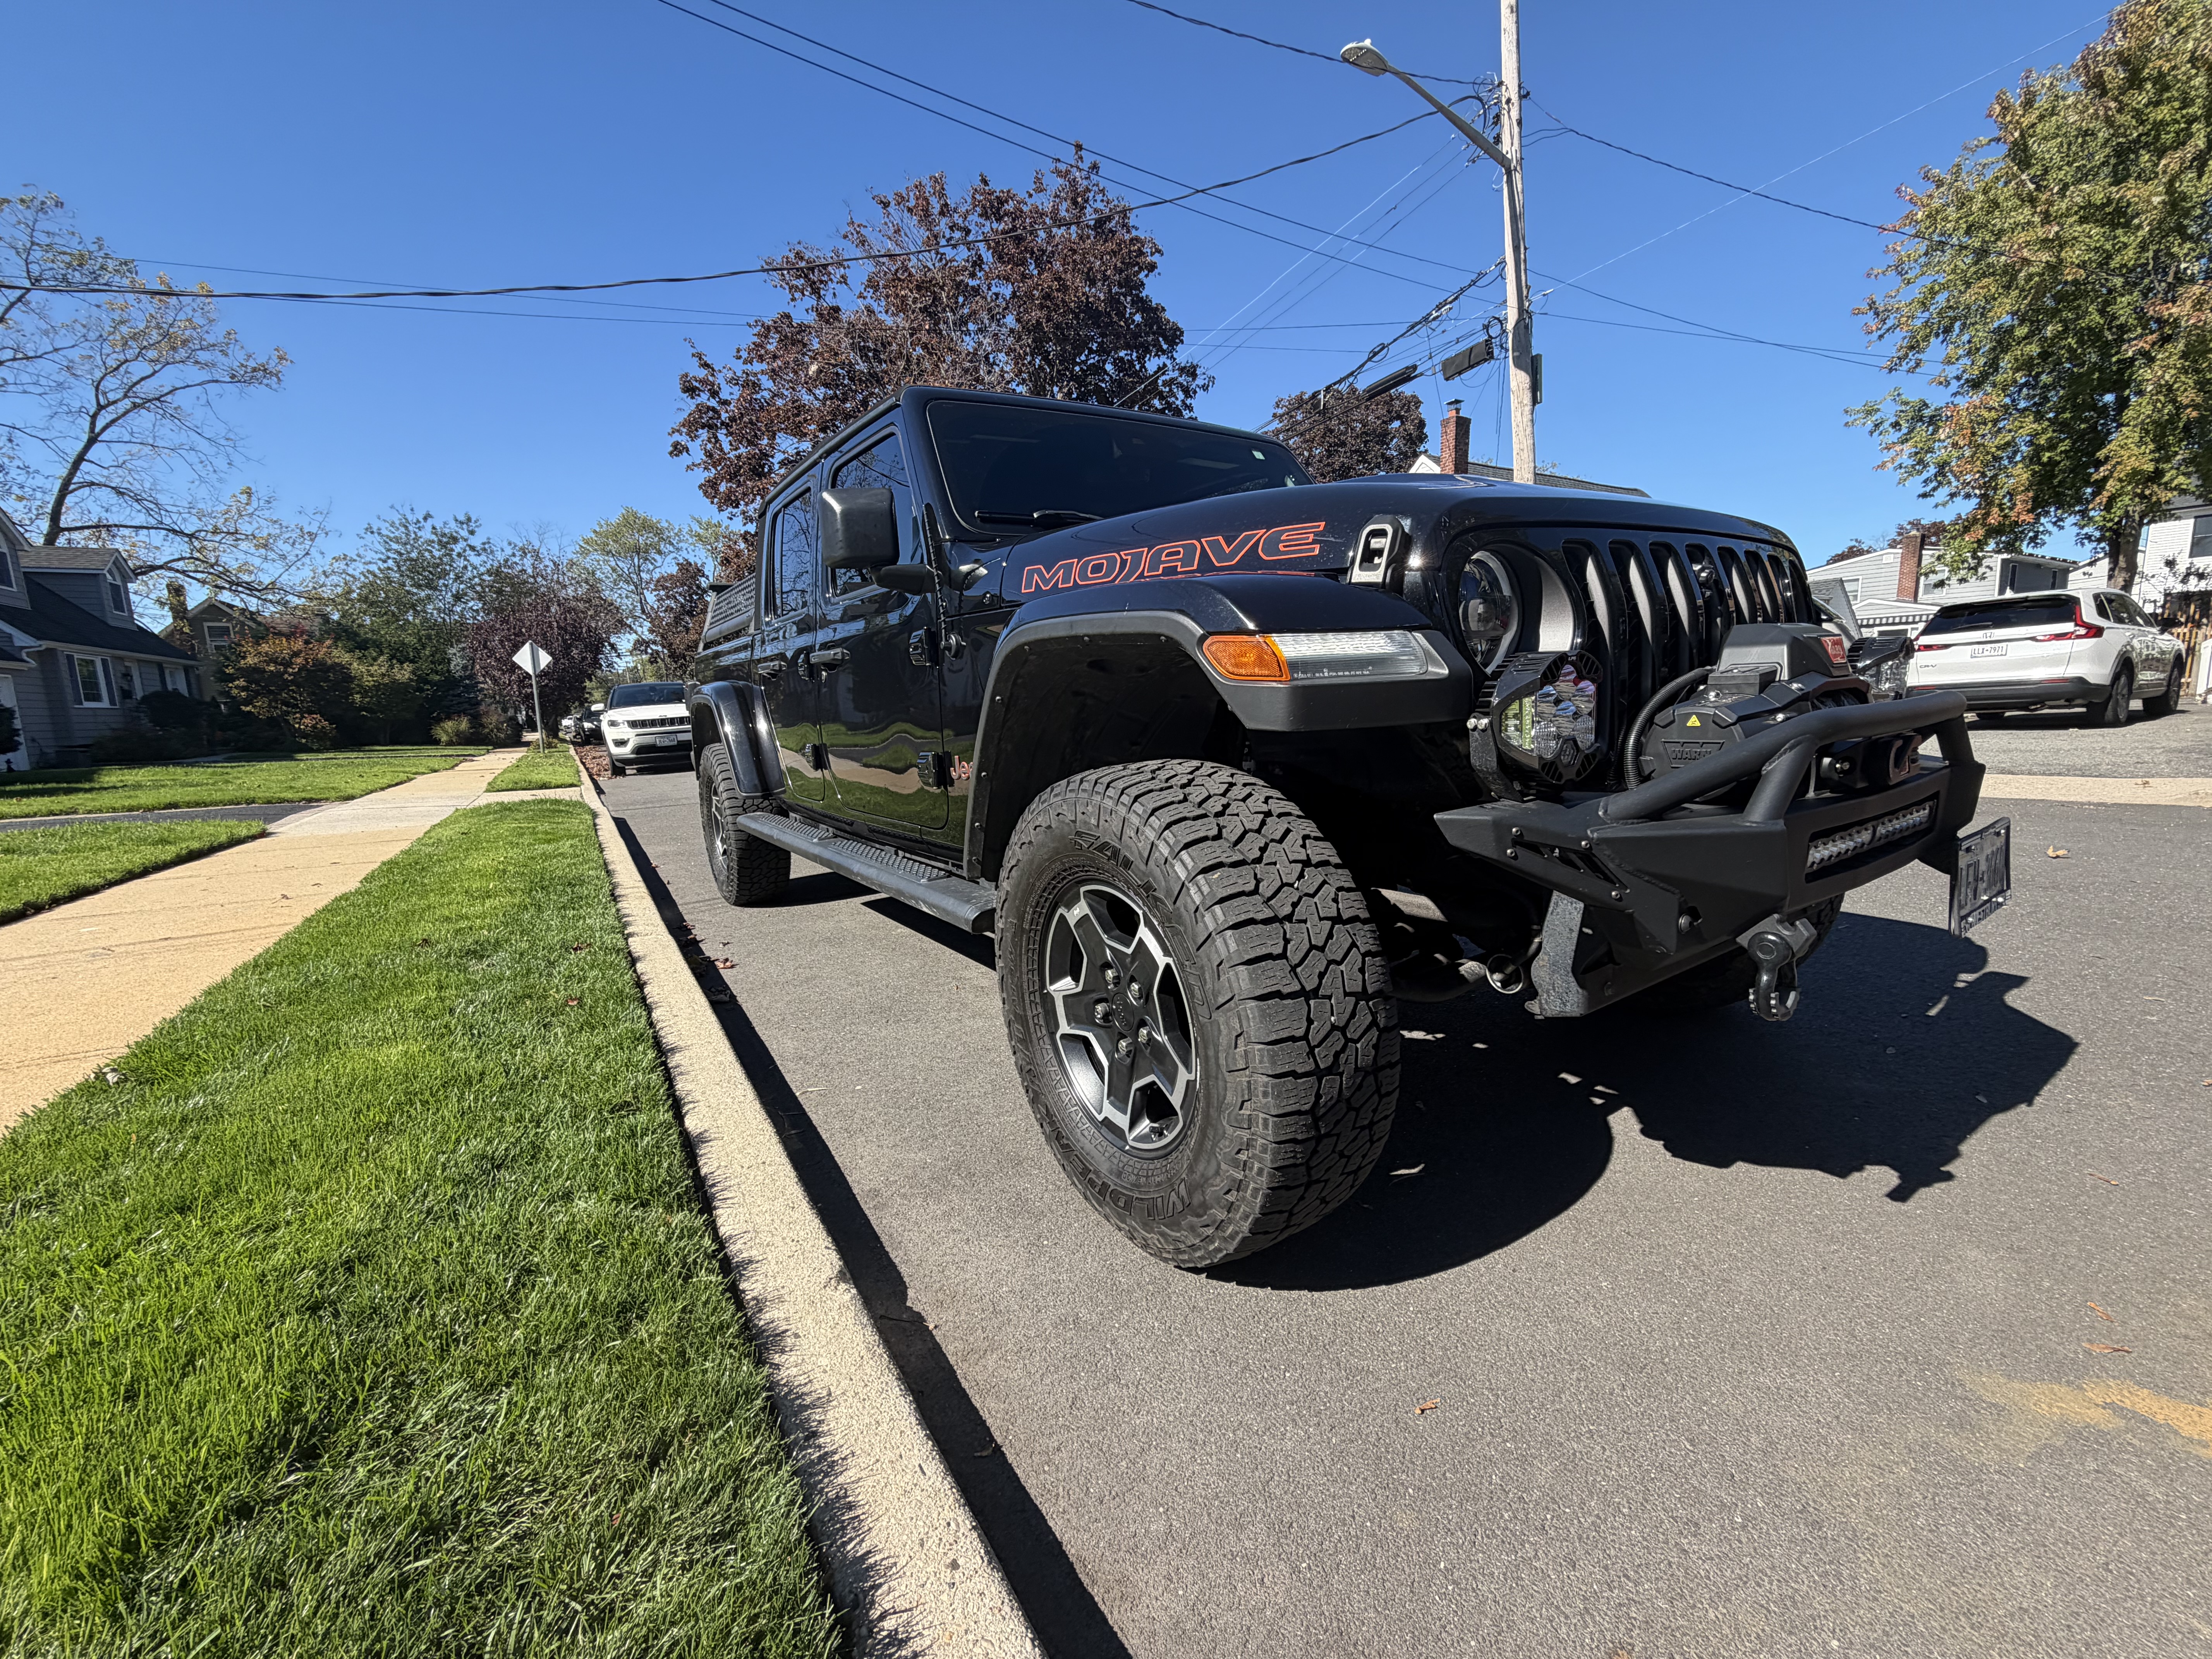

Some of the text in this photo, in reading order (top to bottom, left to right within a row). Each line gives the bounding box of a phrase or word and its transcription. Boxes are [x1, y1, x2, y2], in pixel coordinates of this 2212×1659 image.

[1021, 521, 1326, 593] MOJAVE
[1671, 748, 1712, 760] WARN
[1068, 830, 1212, 1020] FALKEN
[1037, 1103, 1192, 1220] WILDPEAK
